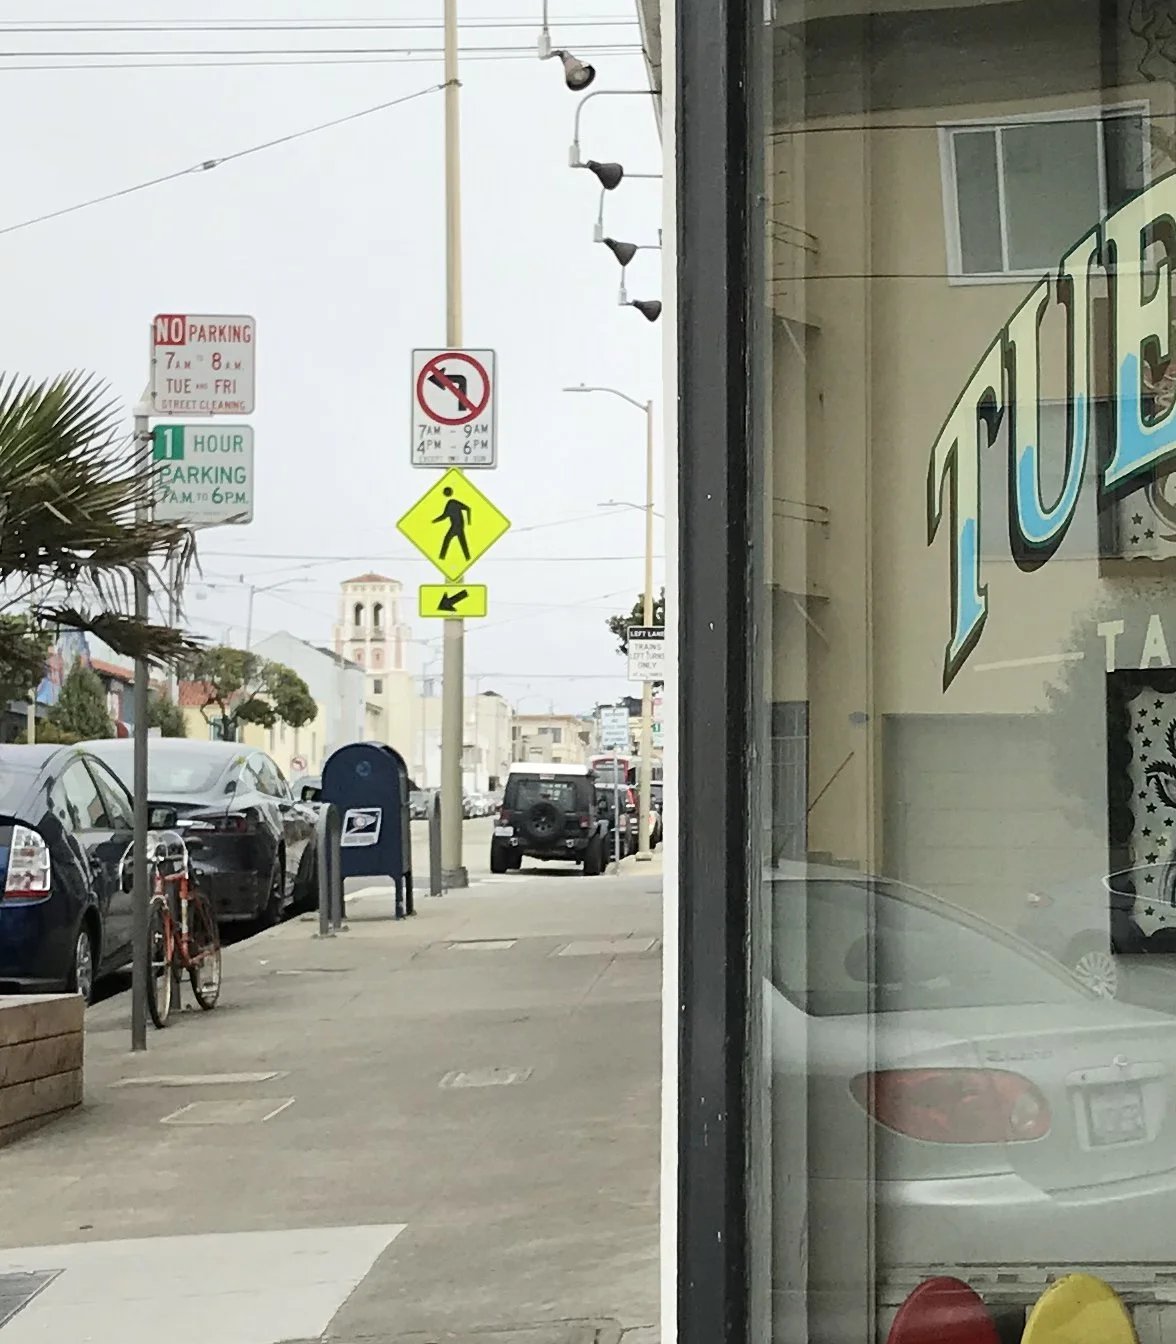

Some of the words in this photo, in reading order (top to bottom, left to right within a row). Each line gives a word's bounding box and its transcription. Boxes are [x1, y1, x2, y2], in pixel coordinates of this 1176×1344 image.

[156, 317, 183, 343] NO
[189, 324, 251, 343] PARKING
[166, 378, 191, 394] TUE
[214, 379, 237, 395] FRI
[162, 399, 197, 410] STREET
[200, 399, 246, 410] CLEANING
[164, 428, 173, 458] 1
[194, 435, 244, 453] HOUR
[160, 466, 247, 485] PARKING
[196, 493, 208, 502] TO
